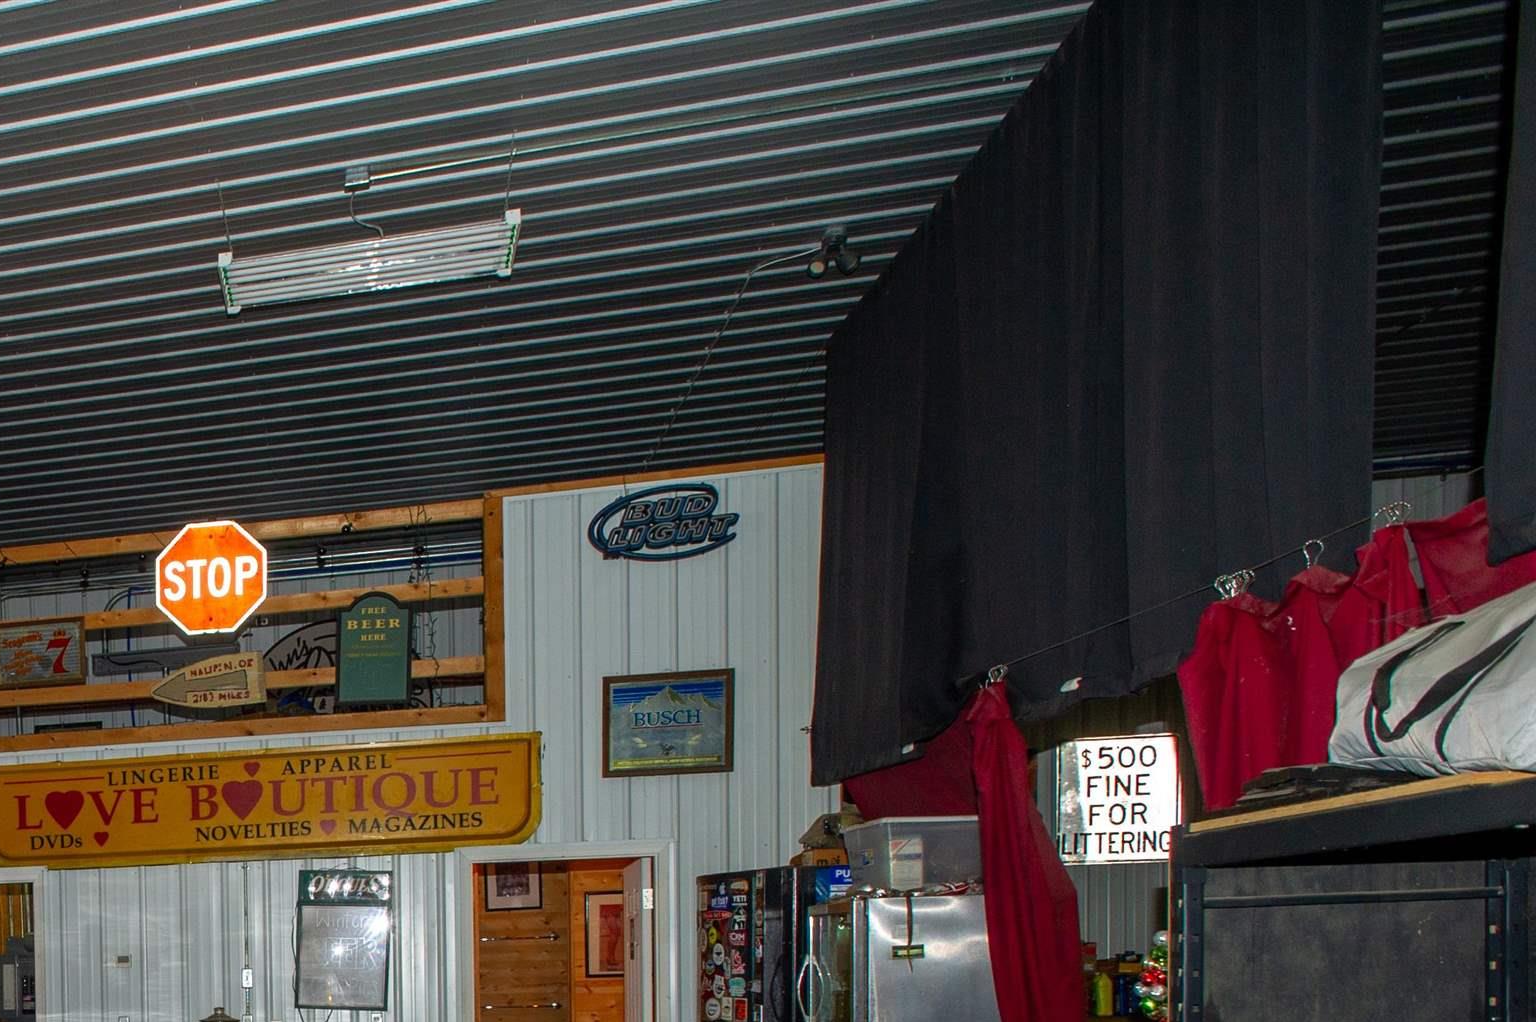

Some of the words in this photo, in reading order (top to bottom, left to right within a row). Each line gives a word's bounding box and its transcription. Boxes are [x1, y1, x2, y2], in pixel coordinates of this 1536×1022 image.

[624, 494, 714, 523] BUD
[607, 514, 739, 550] LIGHT
[164, 555, 258, 601] STOP
[347, 618, 401, 630] BEER
[360, 607, 387, 616] FREE
[360, 633, 387, 641] HERE
[46, 634, 73, 674] 7
[218, 689, 251, 701] MILES
[633, 709, 702, 727] BUSCH
[106, 764, 220, 787] LINGERIE
[281, 753, 392, 775] APPAREL
[1081, 745, 1157, 770] $500
[1087, 773, 1151, 797] FINE
[1089, 803, 1148, 826] FOR
[30, 833, 83, 850] DVDs
[195, 820, 312, 842] NOVELTIES
[348, 812, 484, 834] MAGAZINES
[1061, 830, 1171, 855] LITTERING
